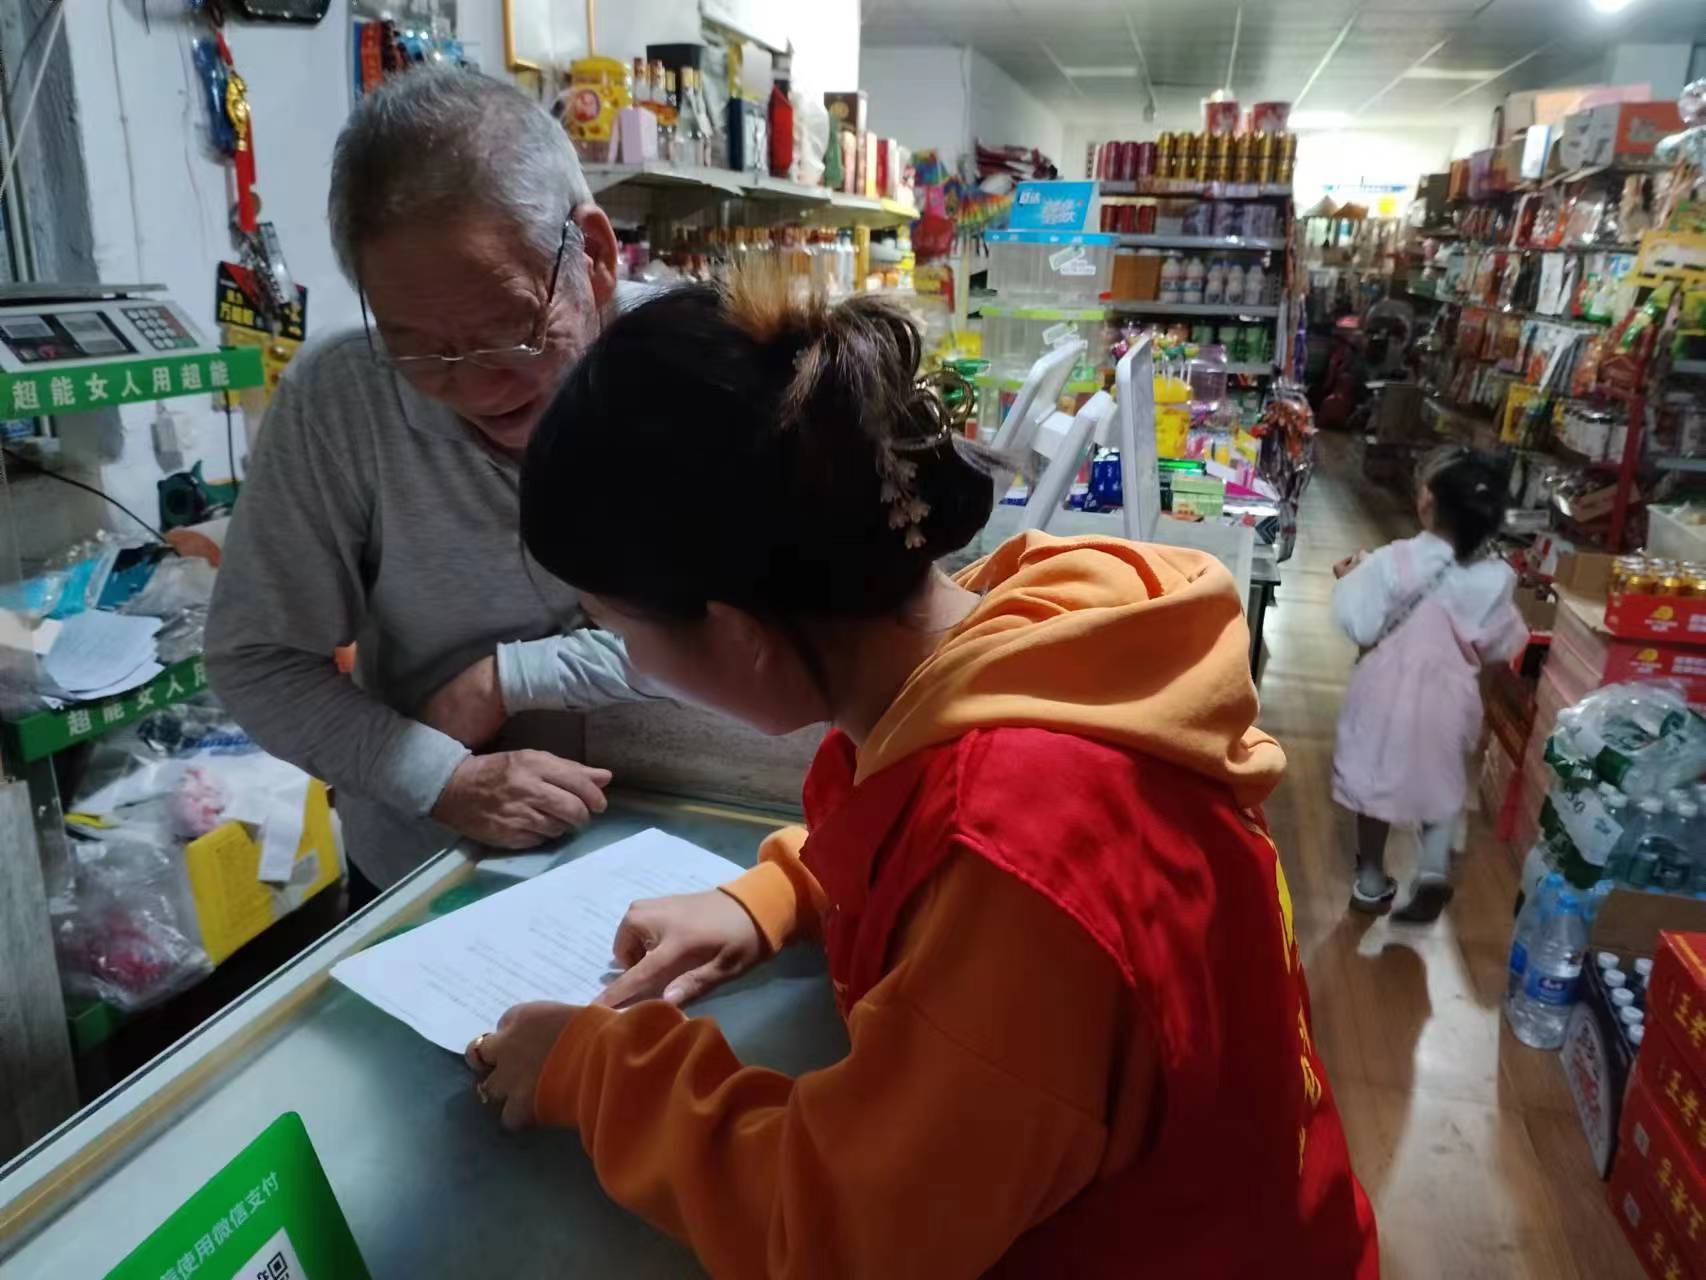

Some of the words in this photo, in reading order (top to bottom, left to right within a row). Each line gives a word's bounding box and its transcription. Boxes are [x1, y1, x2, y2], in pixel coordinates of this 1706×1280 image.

[12, 359, 231, 411] 超能女人用超能
